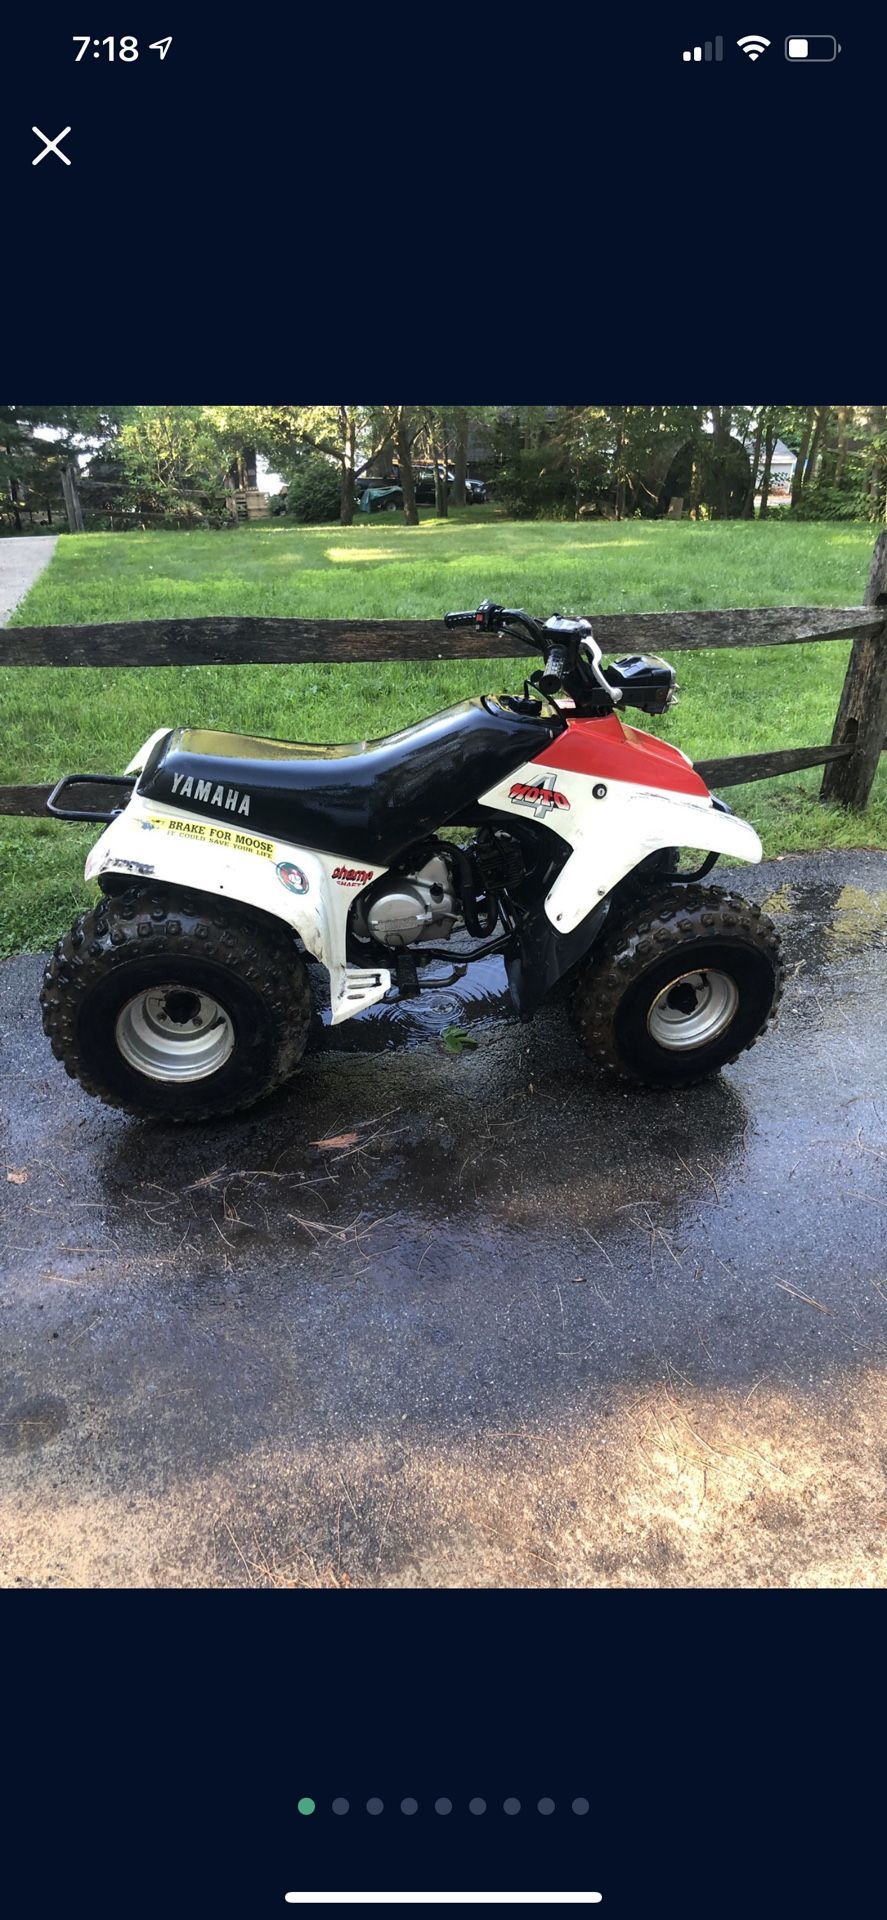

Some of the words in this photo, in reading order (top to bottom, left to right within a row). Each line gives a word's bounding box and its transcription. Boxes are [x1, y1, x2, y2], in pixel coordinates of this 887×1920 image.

[170, 772, 252, 817] YAMAHA
[508, 782, 571, 811] MOTO
[168, 820, 206, 835] BRAKE
[209, 828, 232, 841] FOR
[235, 834, 274, 853] MOOSE
[178, 832, 206, 842] COULD
[208, 838, 230, 847] SAVE
[232, 843, 254, 853] YOUR
[256, 849, 273, 859] LIFE
